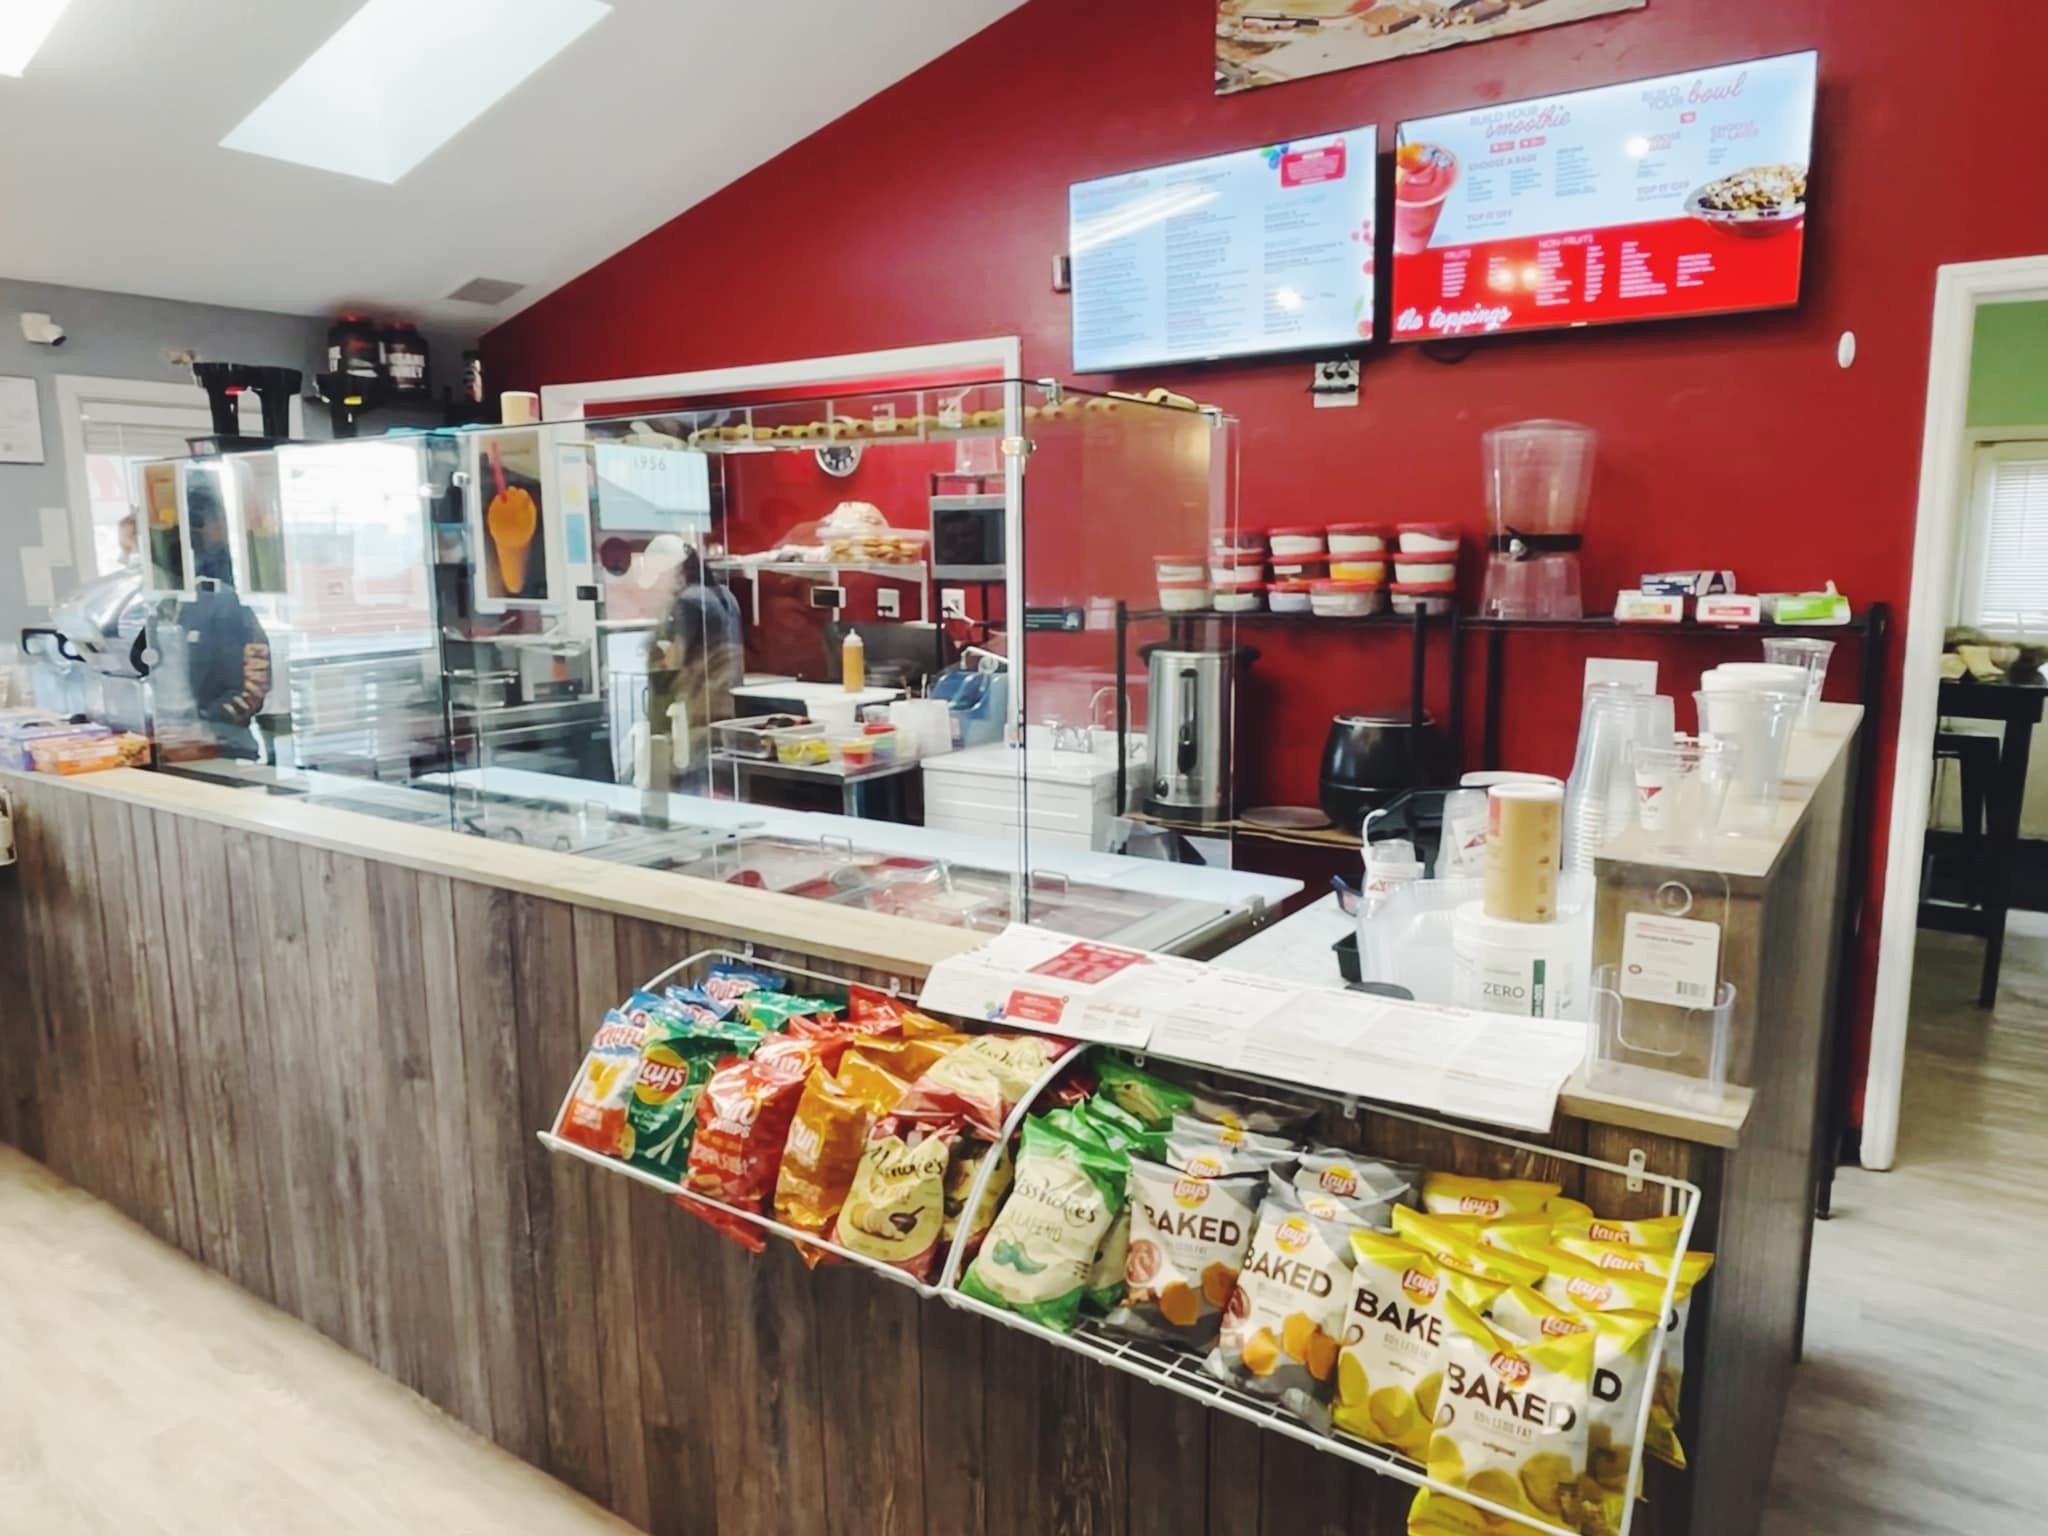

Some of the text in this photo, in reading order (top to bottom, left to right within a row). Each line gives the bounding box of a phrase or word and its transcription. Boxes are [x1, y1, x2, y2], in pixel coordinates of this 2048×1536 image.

[1688, 71, 1747, 104] bowl
[1486, 103, 1571, 138] smoothie
[1428, 302, 1512, 334] toppings
[1482, 981, 1526, 999] ZERO
[1143, 1204, 1241, 1247] BAKED
[1242, 1246, 1333, 1299] BAKED
[1354, 1287, 1443, 1348] BAKE
[1448, 1361, 1577, 1432] BAKED
